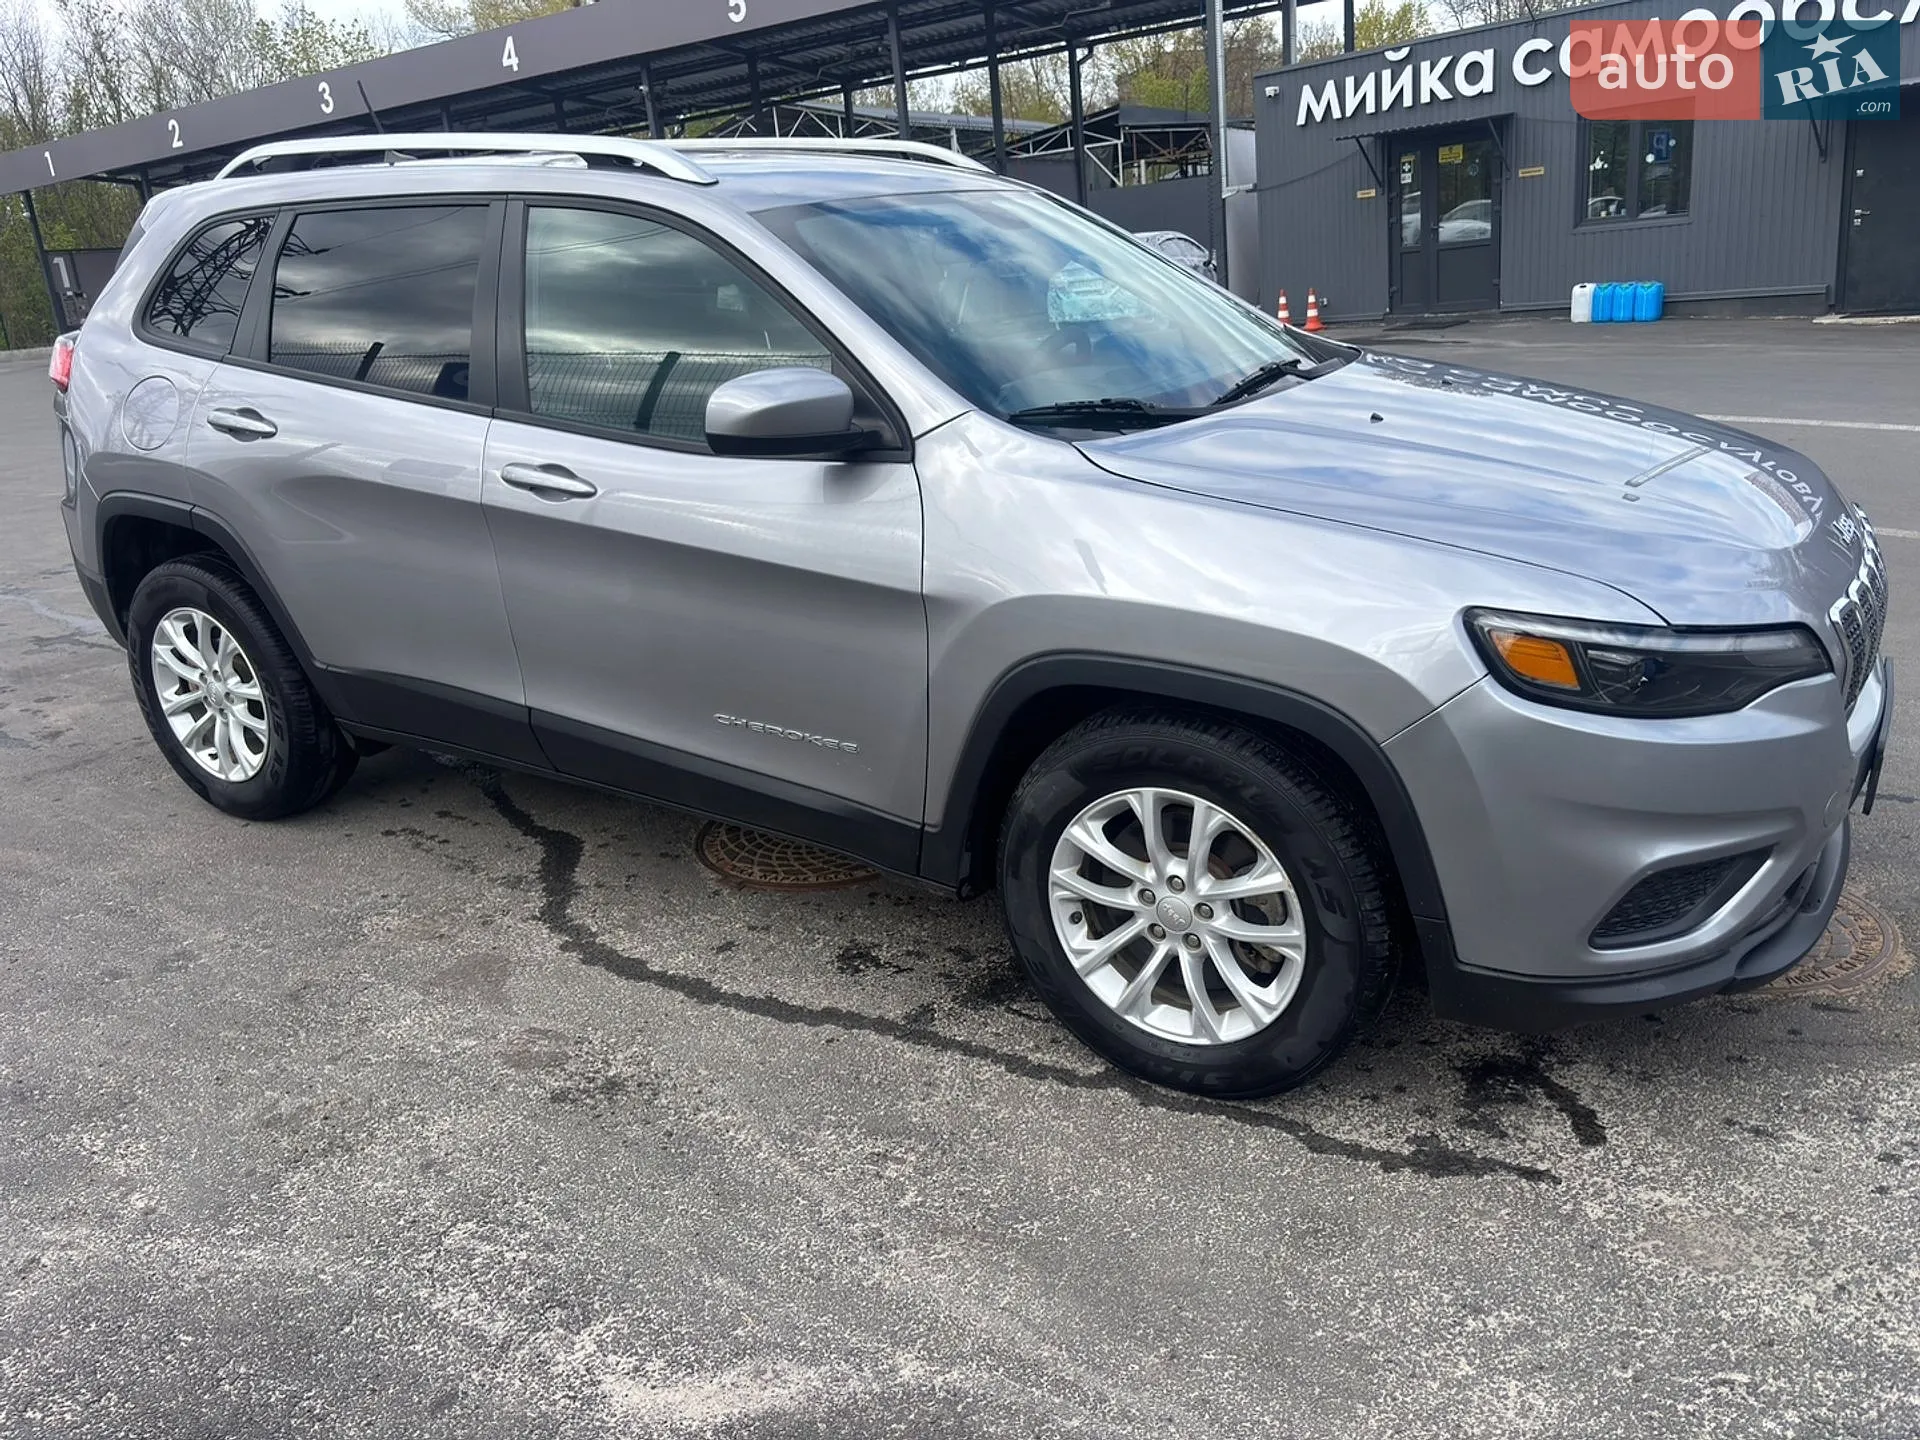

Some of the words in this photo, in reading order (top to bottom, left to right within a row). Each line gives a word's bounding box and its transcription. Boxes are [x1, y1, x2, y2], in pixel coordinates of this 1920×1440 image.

[728, 0, 747, 23] 5
[502, 36, 519, 72] 4
[318, 81, 335, 114] 3
[1296, 47, 1495, 126] мийка
[168, 118, 184, 149] 2
[44, 150, 56, 178] 1
[52, 256, 71, 289] 1
[713, 712, 860, 754] CHEROKEE
